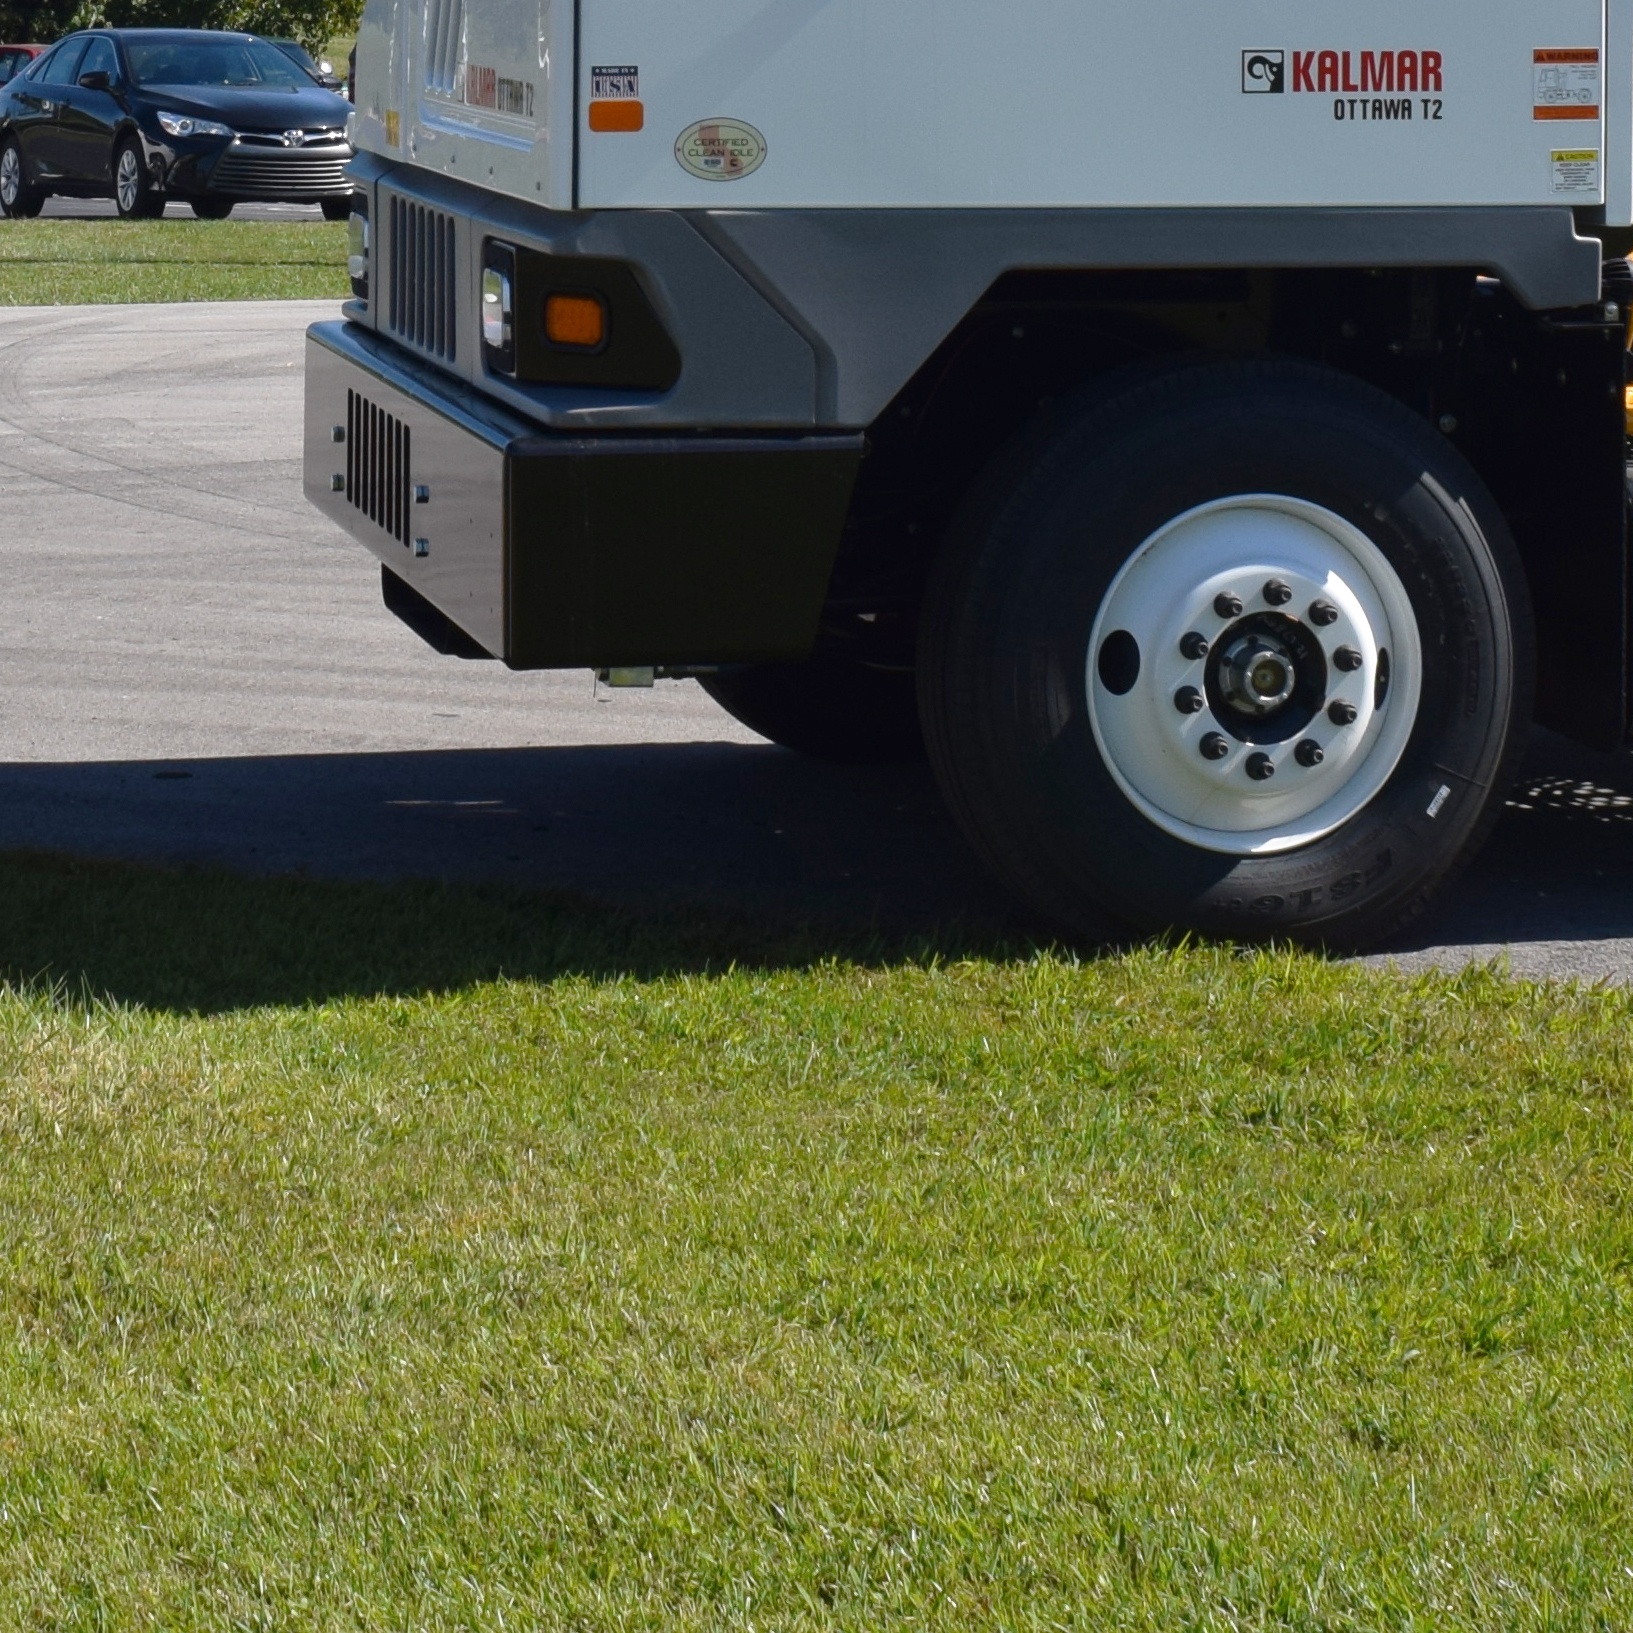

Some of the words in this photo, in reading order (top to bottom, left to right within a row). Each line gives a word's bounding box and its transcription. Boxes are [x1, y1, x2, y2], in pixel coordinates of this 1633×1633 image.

[1292, 50, 1442, 93] KALMAR
[594, 79, 636, 93] USA
[1333, 98, 1412, 120] OTTAWA
[1421, 98, 1443, 120] T2
[693, 138, 749, 147] CERTIFIED
[688, 149, 725, 157] CLEAN
[729, 149, 754, 157] IDLE
